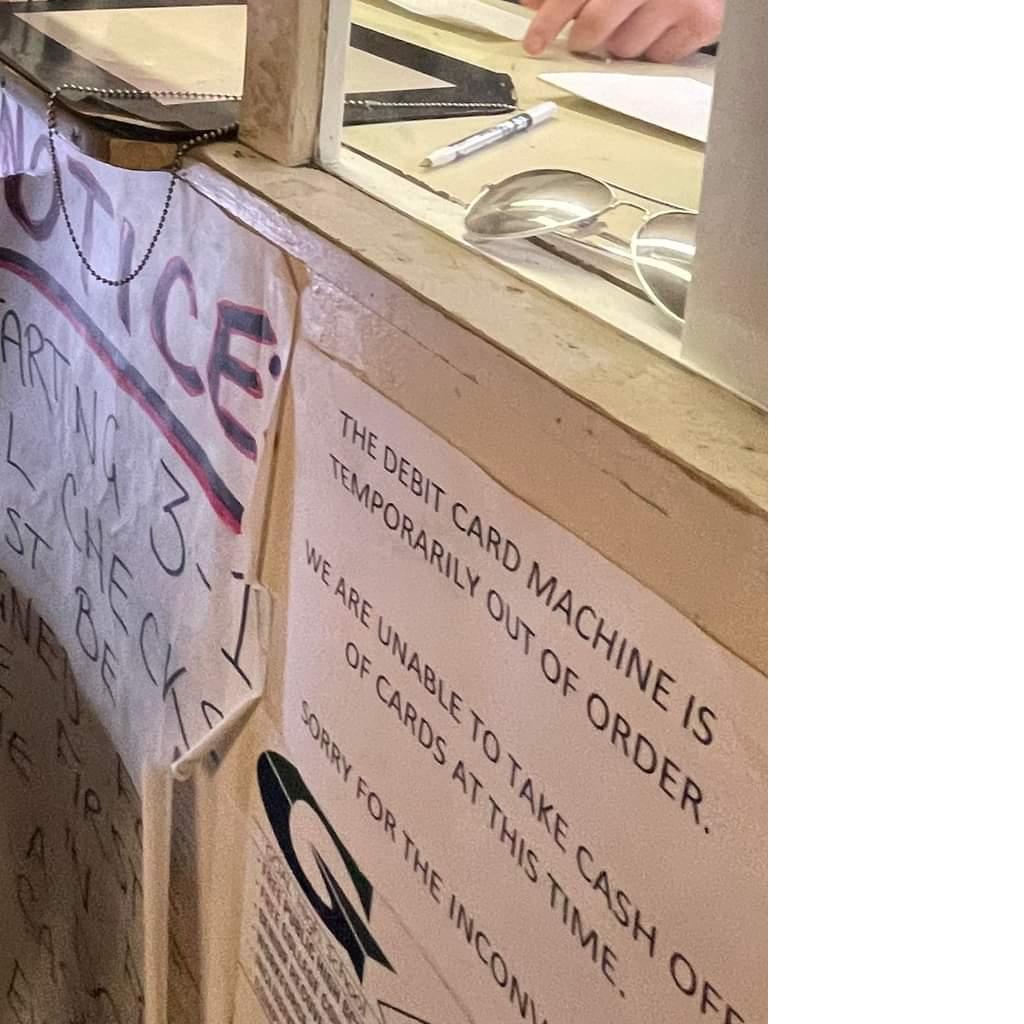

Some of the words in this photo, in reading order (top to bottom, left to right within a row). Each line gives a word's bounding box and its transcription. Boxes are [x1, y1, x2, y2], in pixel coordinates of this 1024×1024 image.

[76, 586, 117, 707] BE
[304, 538, 332, 587] WE
[335, 576, 372, 629] ARE
[378, 615, 462, 725] UNABLE
[470, 708, 501, 766] TO
[508, 757, 569, 853] TAKE
[577, 845, 657, 958] CASH
[329, 452, 480, 600] TEMPORARILY
[486, 588, 535, 656] OUT
[541, 647, 579, 698] OF
[586, 692, 712, 835] ORDER.
[338, 409, 377, 461] THE
[384, 444, 445, 513] DEBIT
[452, 501, 521, 574] CARD
[527, 560, 675, 712] MACHINE
[682, 694, 718, 747] IS
[301, 699, 352, 785] SORRY
[356, 775, 397, 843] FOR
[401, 829, 442, 904] THE
[345, 641, 373, 681] OF
[375, 674, 449, 767] CARDS
[452, 758, 486, 806] AT
[487, 795, 539, 884] THIS
[547, 872, 626, 999] TIME.
